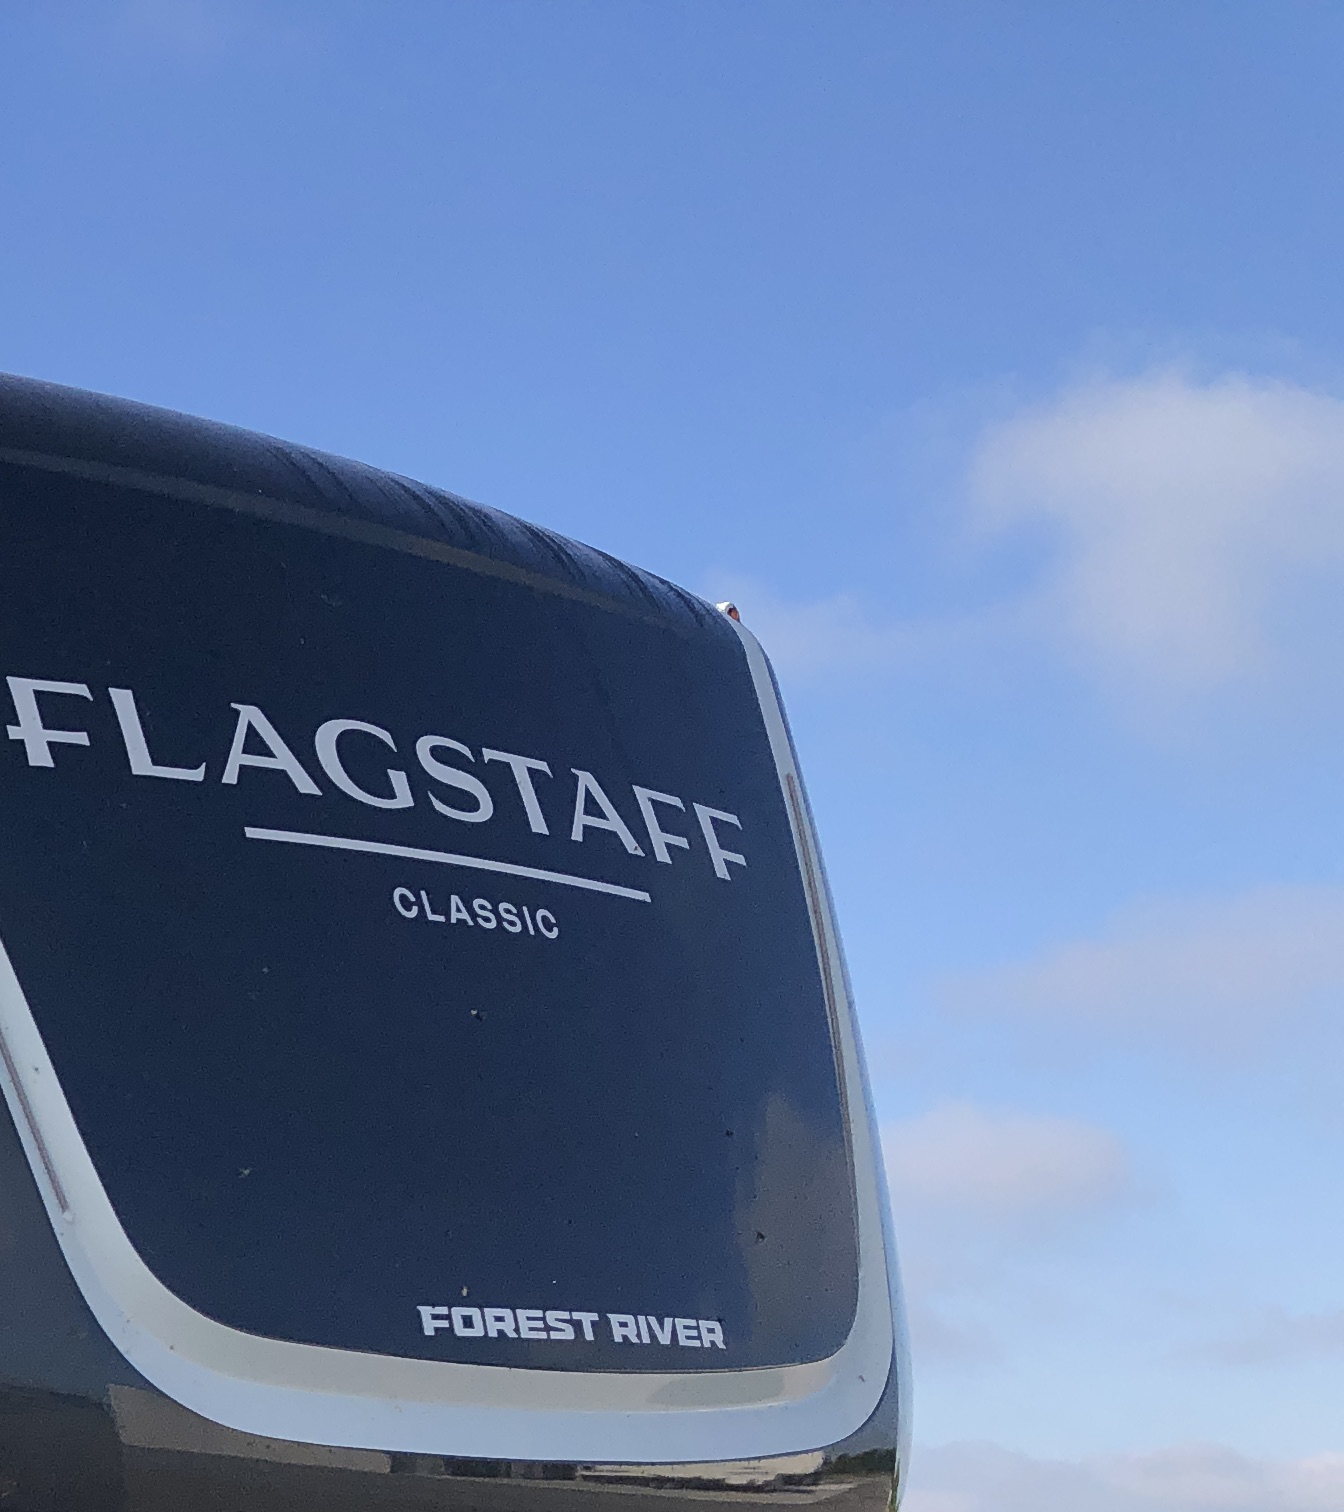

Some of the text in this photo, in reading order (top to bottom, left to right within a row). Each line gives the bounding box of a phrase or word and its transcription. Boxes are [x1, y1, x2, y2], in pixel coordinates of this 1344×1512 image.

[6, 675, 749, 882] FLAGSTAFF
[392, 885, 560, 940] CLASSIC
[419, 1304, 727, 1350] FOREST RIVER
